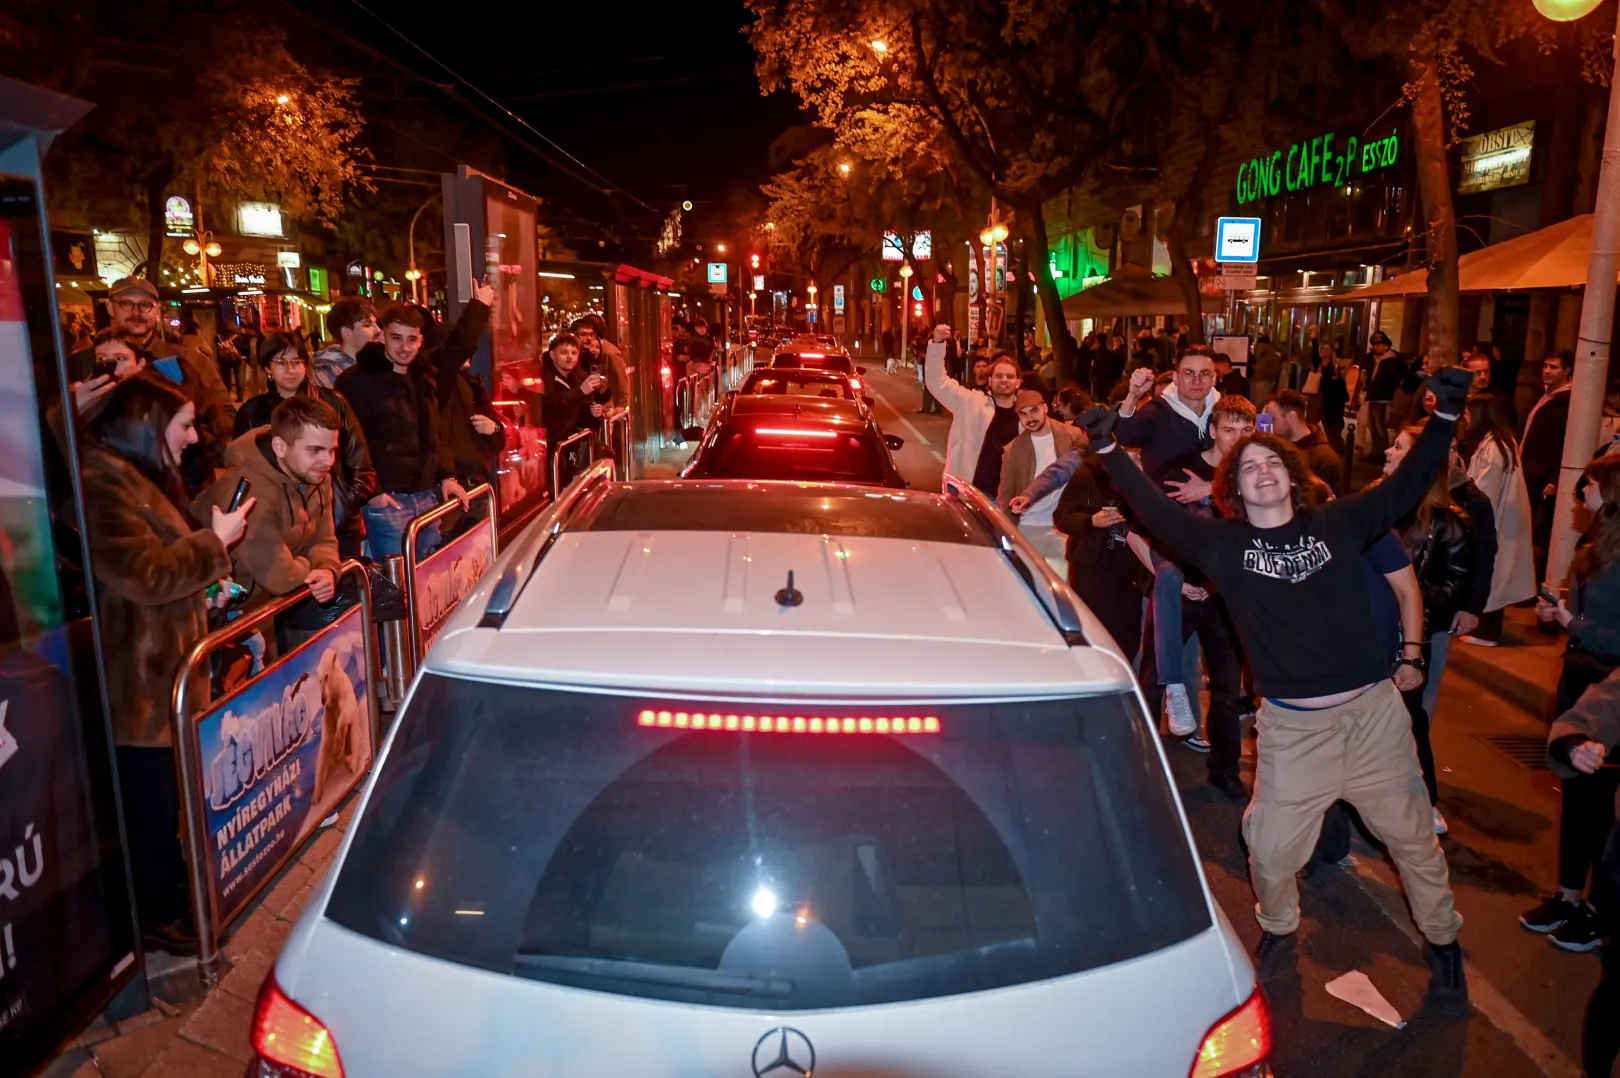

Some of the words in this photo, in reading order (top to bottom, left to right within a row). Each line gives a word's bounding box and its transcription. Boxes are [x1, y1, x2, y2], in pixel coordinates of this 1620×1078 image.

[1237, 150, 1281, 205] GONG
[1286, 132, 1335, 191] CAFE
[1480, 128, 1516, 154] OBSIT
[1246, 550, 1283, 577] BLUE
[1283, 541, 1331, 577] DENIM
[211, 688, 310, 811] JÉGVILÁG
[216, 758, 301, 851] NYÍREGYHÁZI
[220, 794, 292, 880] ÁLLATPARK
